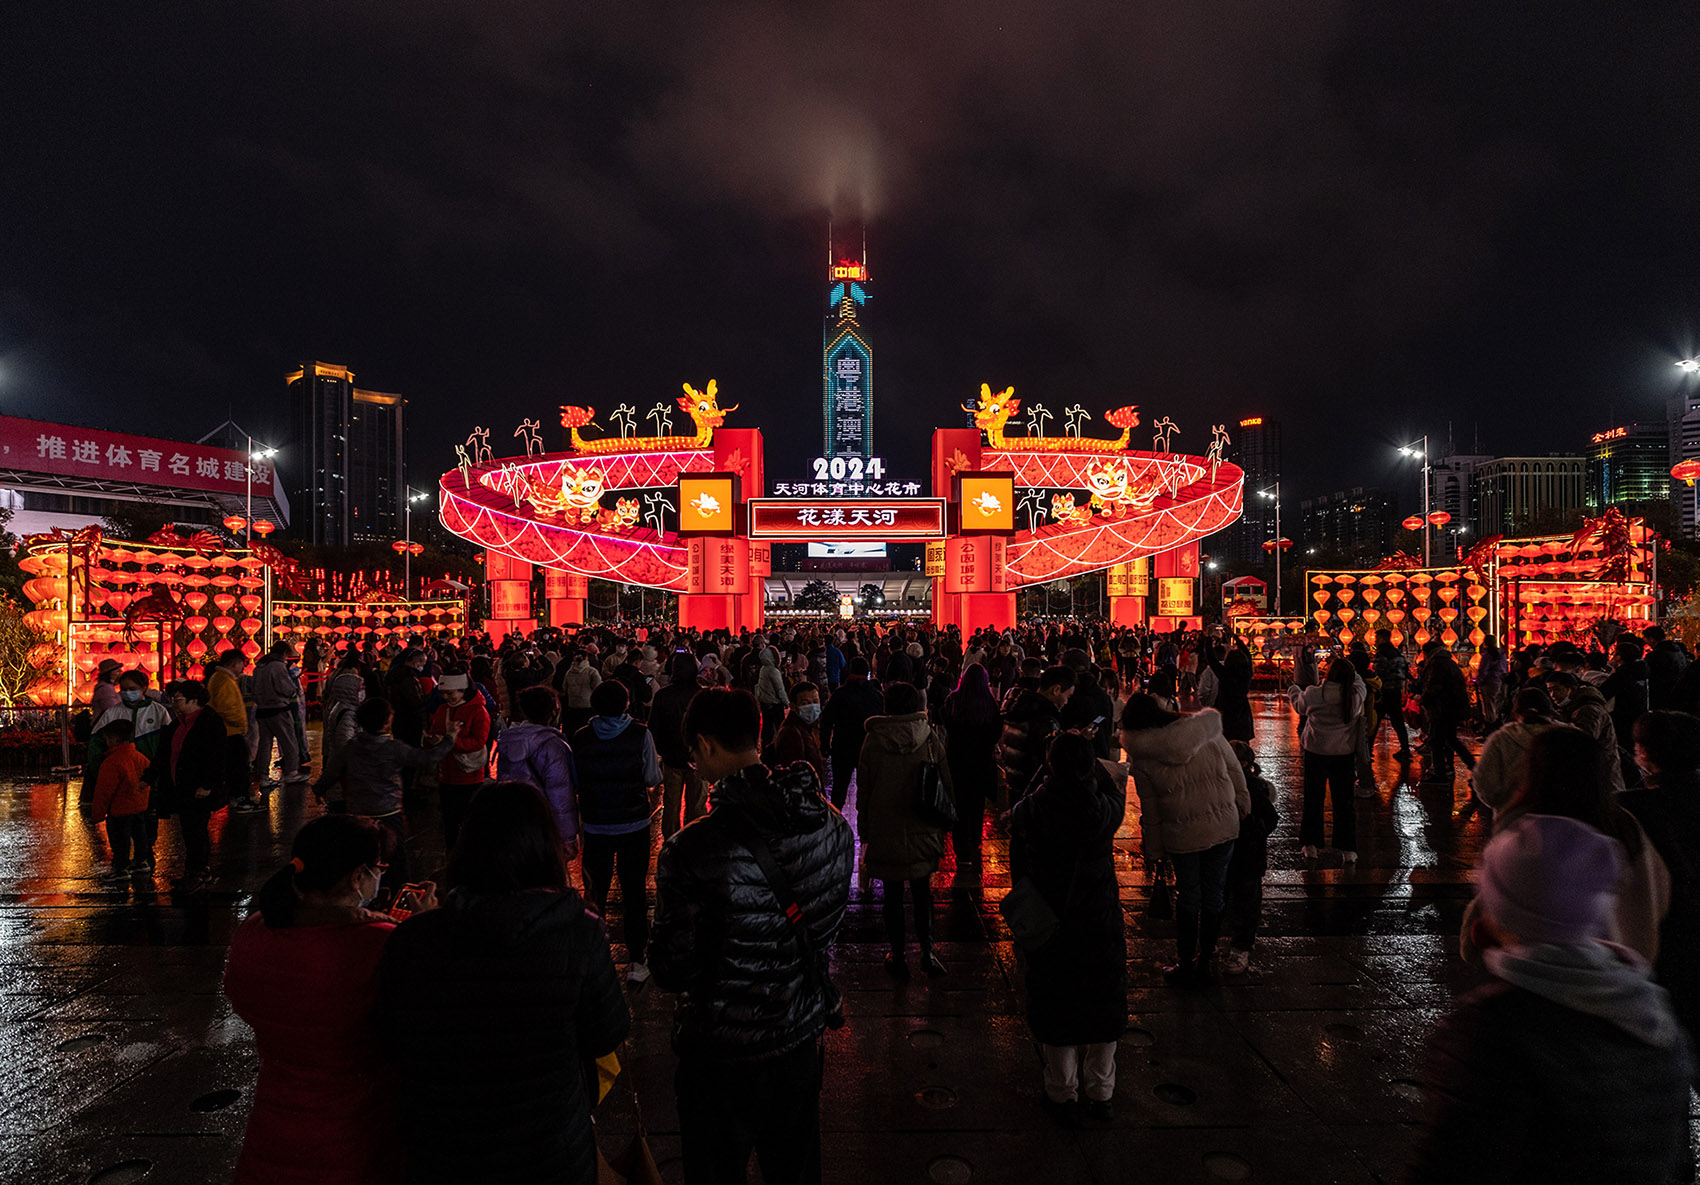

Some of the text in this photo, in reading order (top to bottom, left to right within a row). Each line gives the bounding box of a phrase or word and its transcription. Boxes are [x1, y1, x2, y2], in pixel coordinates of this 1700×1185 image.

[834, 266, 861, 279] 中信
[813, 457, 886, 480] 2024
[774, 481, 921, 496] 天河体育中心花市
[797, 508, 898, 526] 花漾天河
[960, 543, 975, 585] 公园城区
